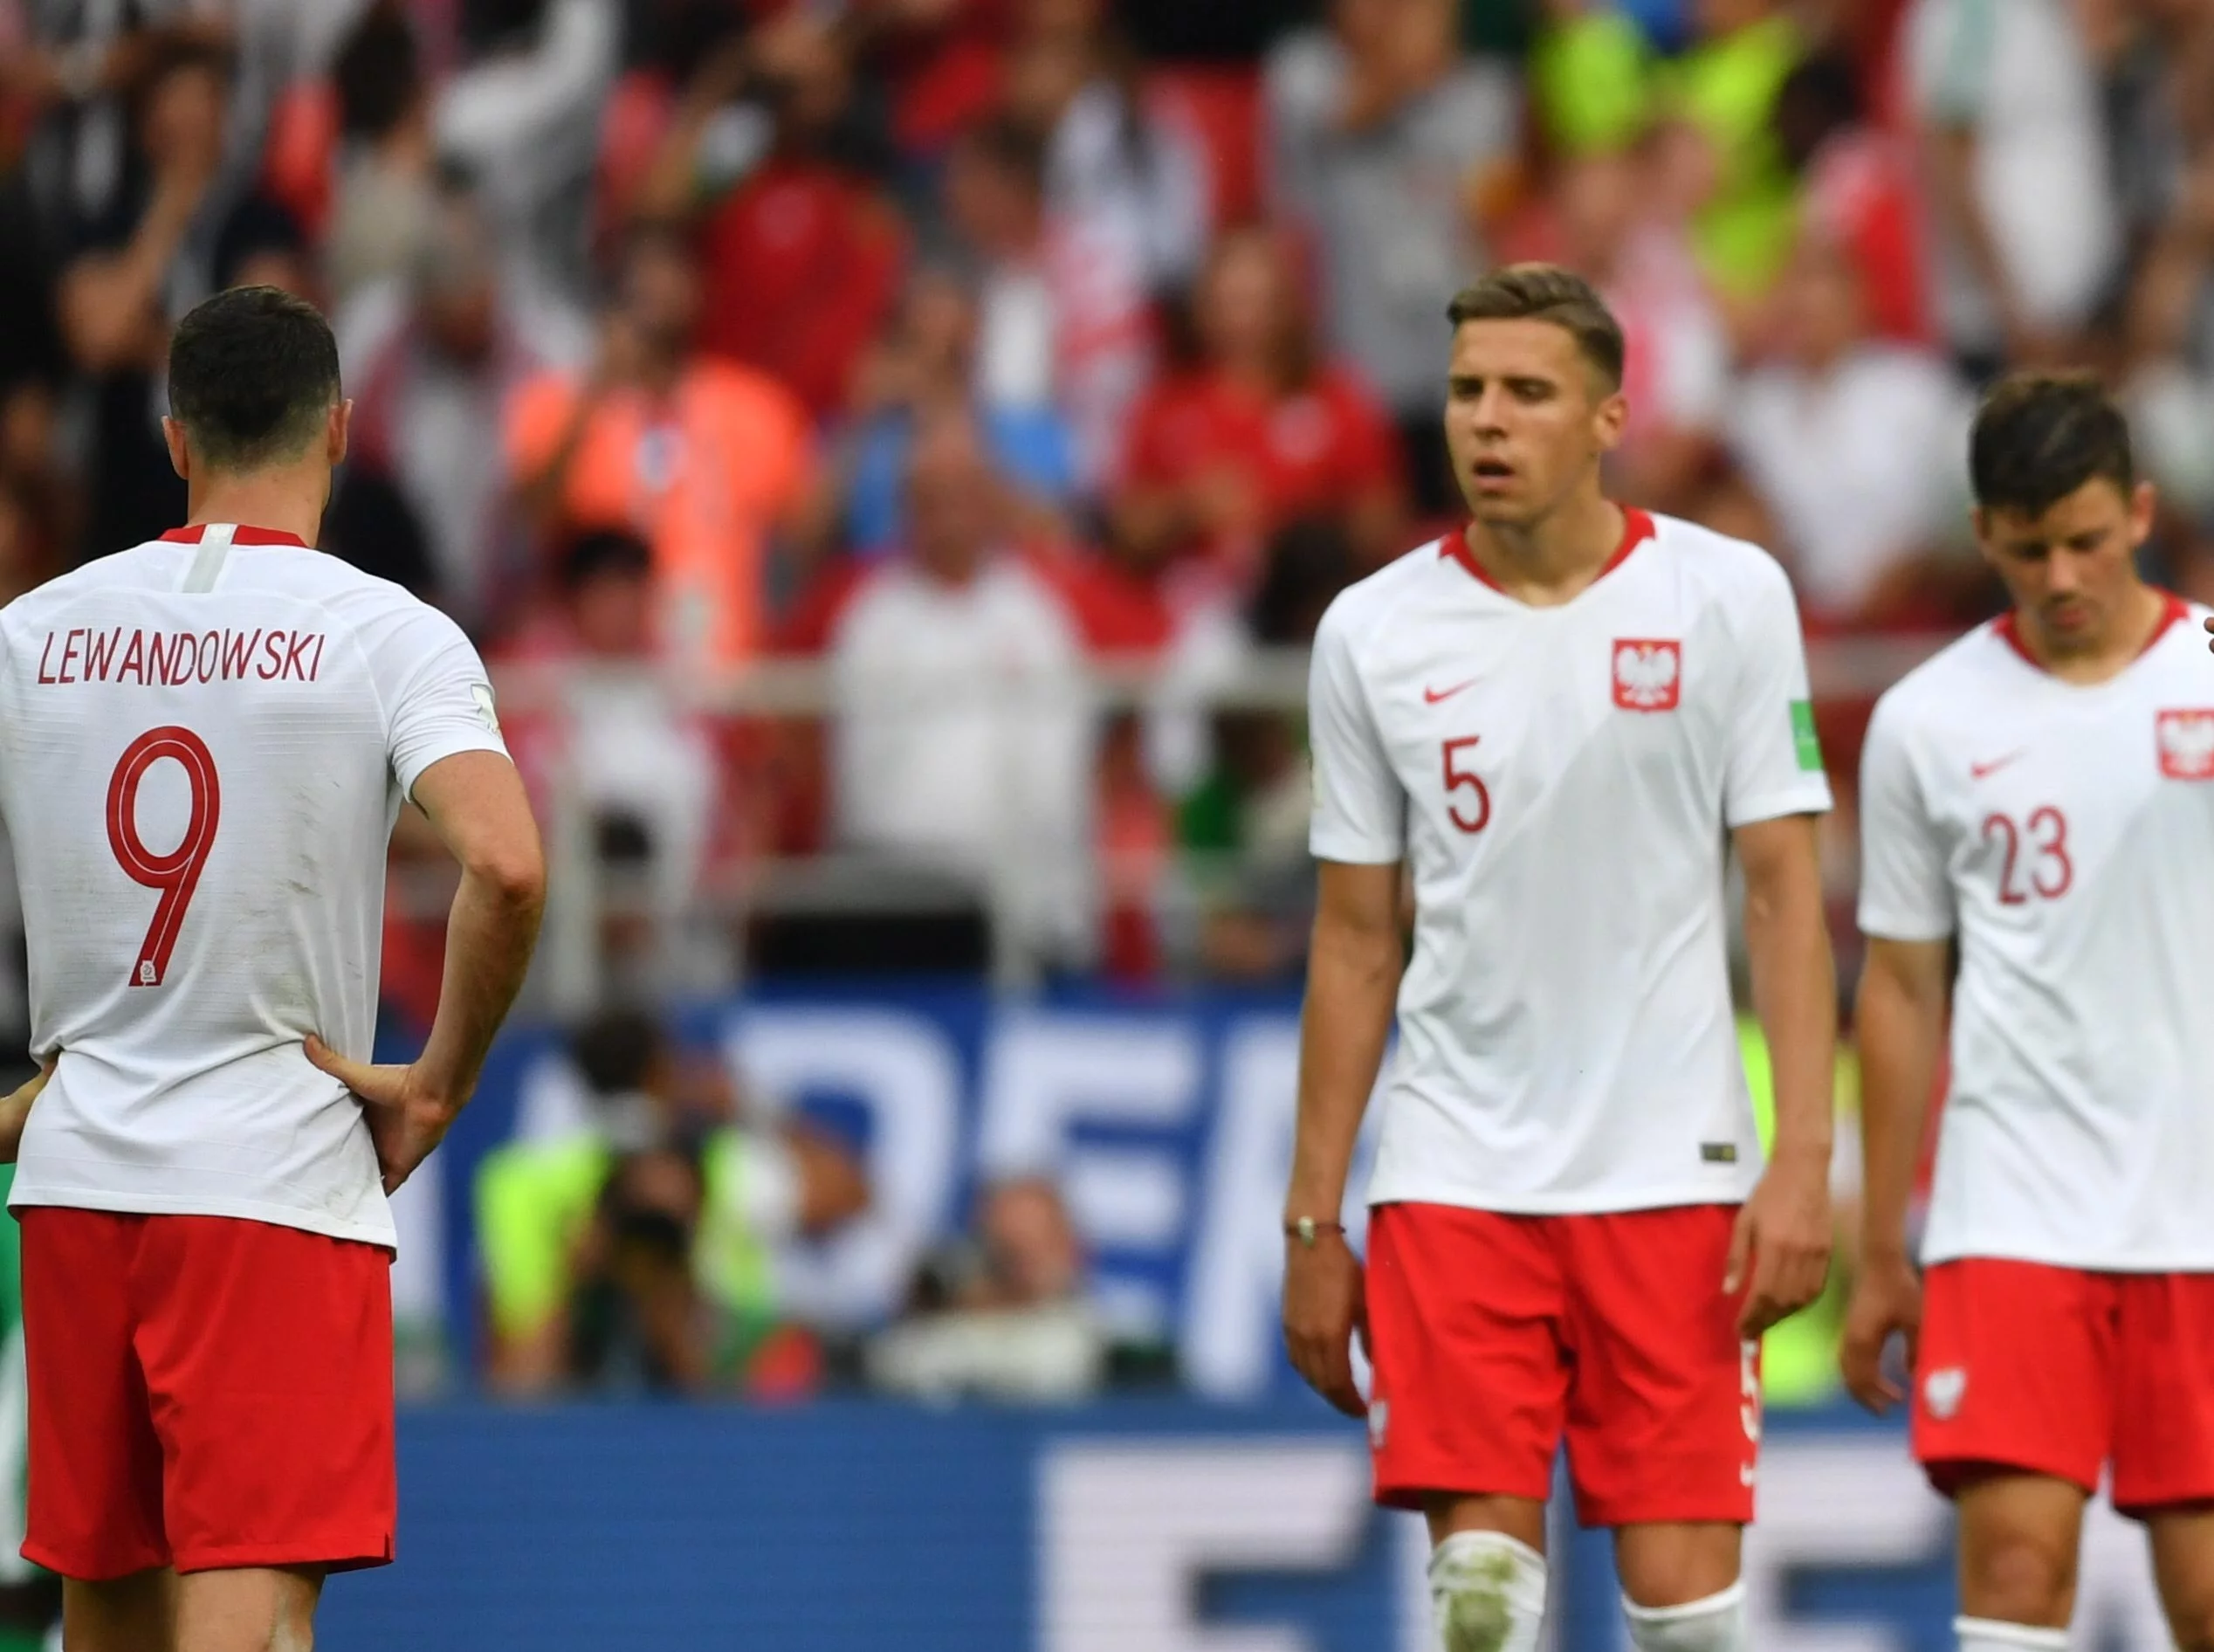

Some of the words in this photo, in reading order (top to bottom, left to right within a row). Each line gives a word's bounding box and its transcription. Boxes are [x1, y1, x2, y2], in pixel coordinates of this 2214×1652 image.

[38, 626, 326, 686] LEWANDOWSKI
[1440, 735, 1491, 834] 5
[106, 725, 221, 987] 9
[1982, 805, 2073, 906] 23
